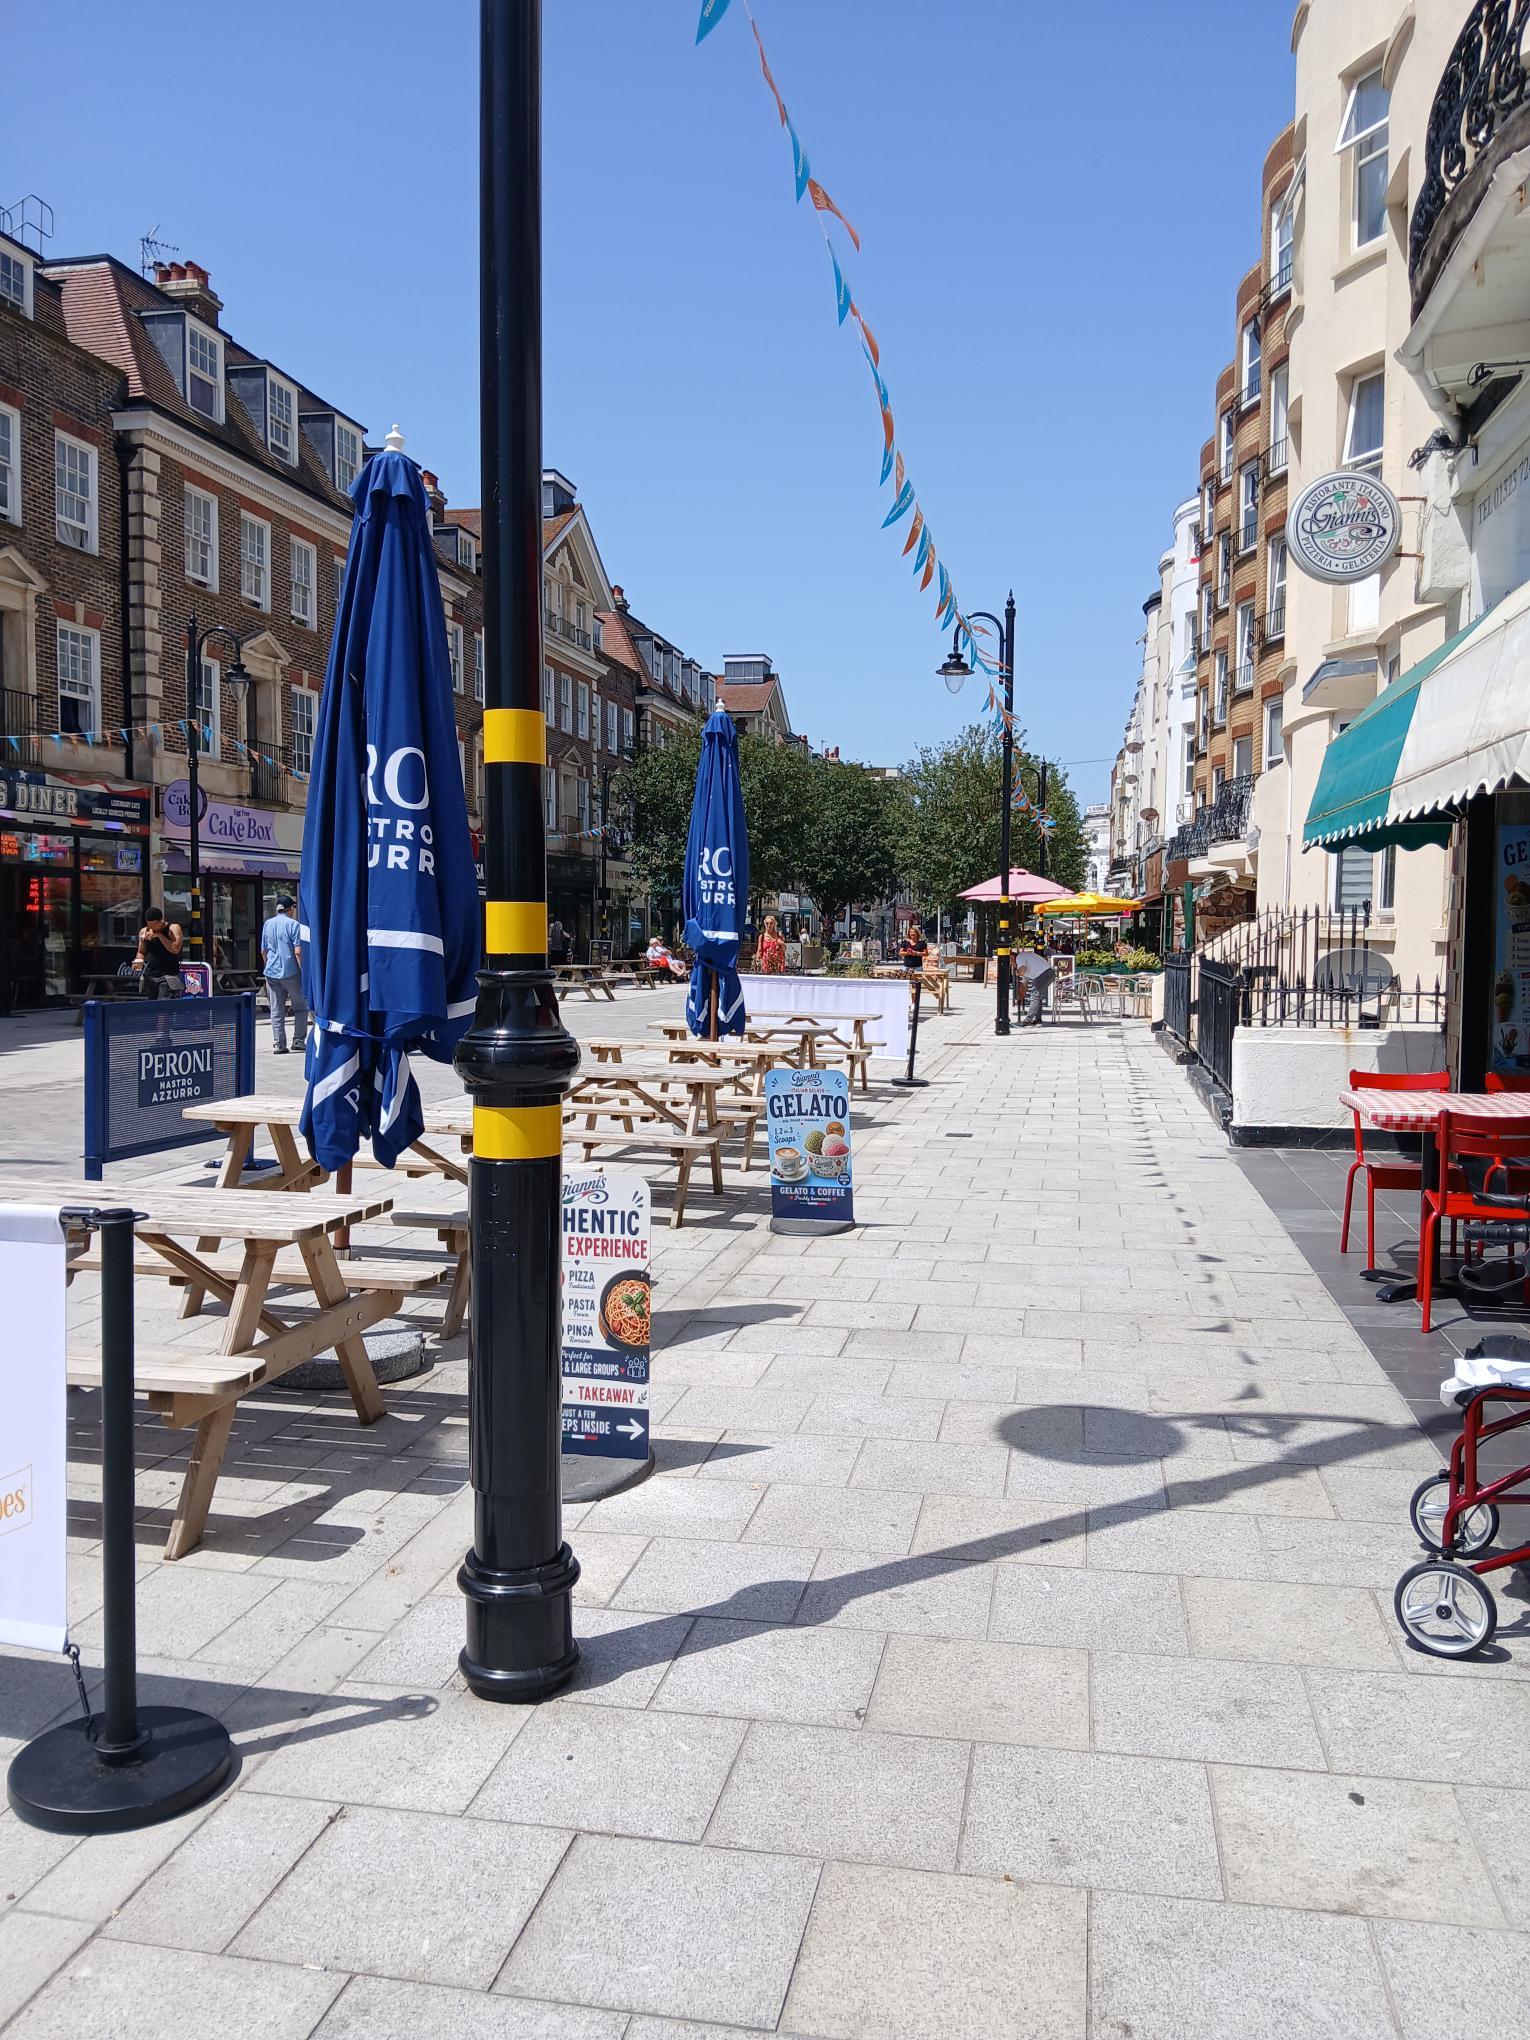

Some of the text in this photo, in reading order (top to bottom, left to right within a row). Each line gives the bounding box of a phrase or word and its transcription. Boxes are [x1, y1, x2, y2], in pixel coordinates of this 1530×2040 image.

[1305, 481, 1390, 519] RISTORANTE ITALIANO
[1477, 494, 1493, 525] TEL
[1302, 536, 1387, 570] PIZZERIA GELATERIA
[15, 782, 78, 816] DINER
[168, 794, 190, 805] Cak
[209, 813, 272, 842] Cake Box
[141, 1048, 213, 1081] PERONI
[160, 1077, 193, 1090] NASTRO
[151, 1086, 201, 1103] AZZURRO
[769, 1094, 847, 1119] GELATO
[774, 1135, 797, 1145] Scoops
[780, 1187, 846, 1197] GELATO & COFFEE
[563, 1208, 640, 1236] HENTIC
[567, 1236, 648, 1259] EXPERIENCE
[569, 1270, 595, 1283] PIZZA
[568, 1298, 595, 1311] PASTA
[567, 1324, 594, 1337] PINSA
[562, 1350, 593, 1362] Perfect for
[564, 1361, 619, 1377] & LARGE GROUPS
[578, 1385, 635, 1404] TAKEAWAY
[562, 1408, 596, 1419] JUST A FEW
[562, 1418, 610, 1434] EPS INSIDE
